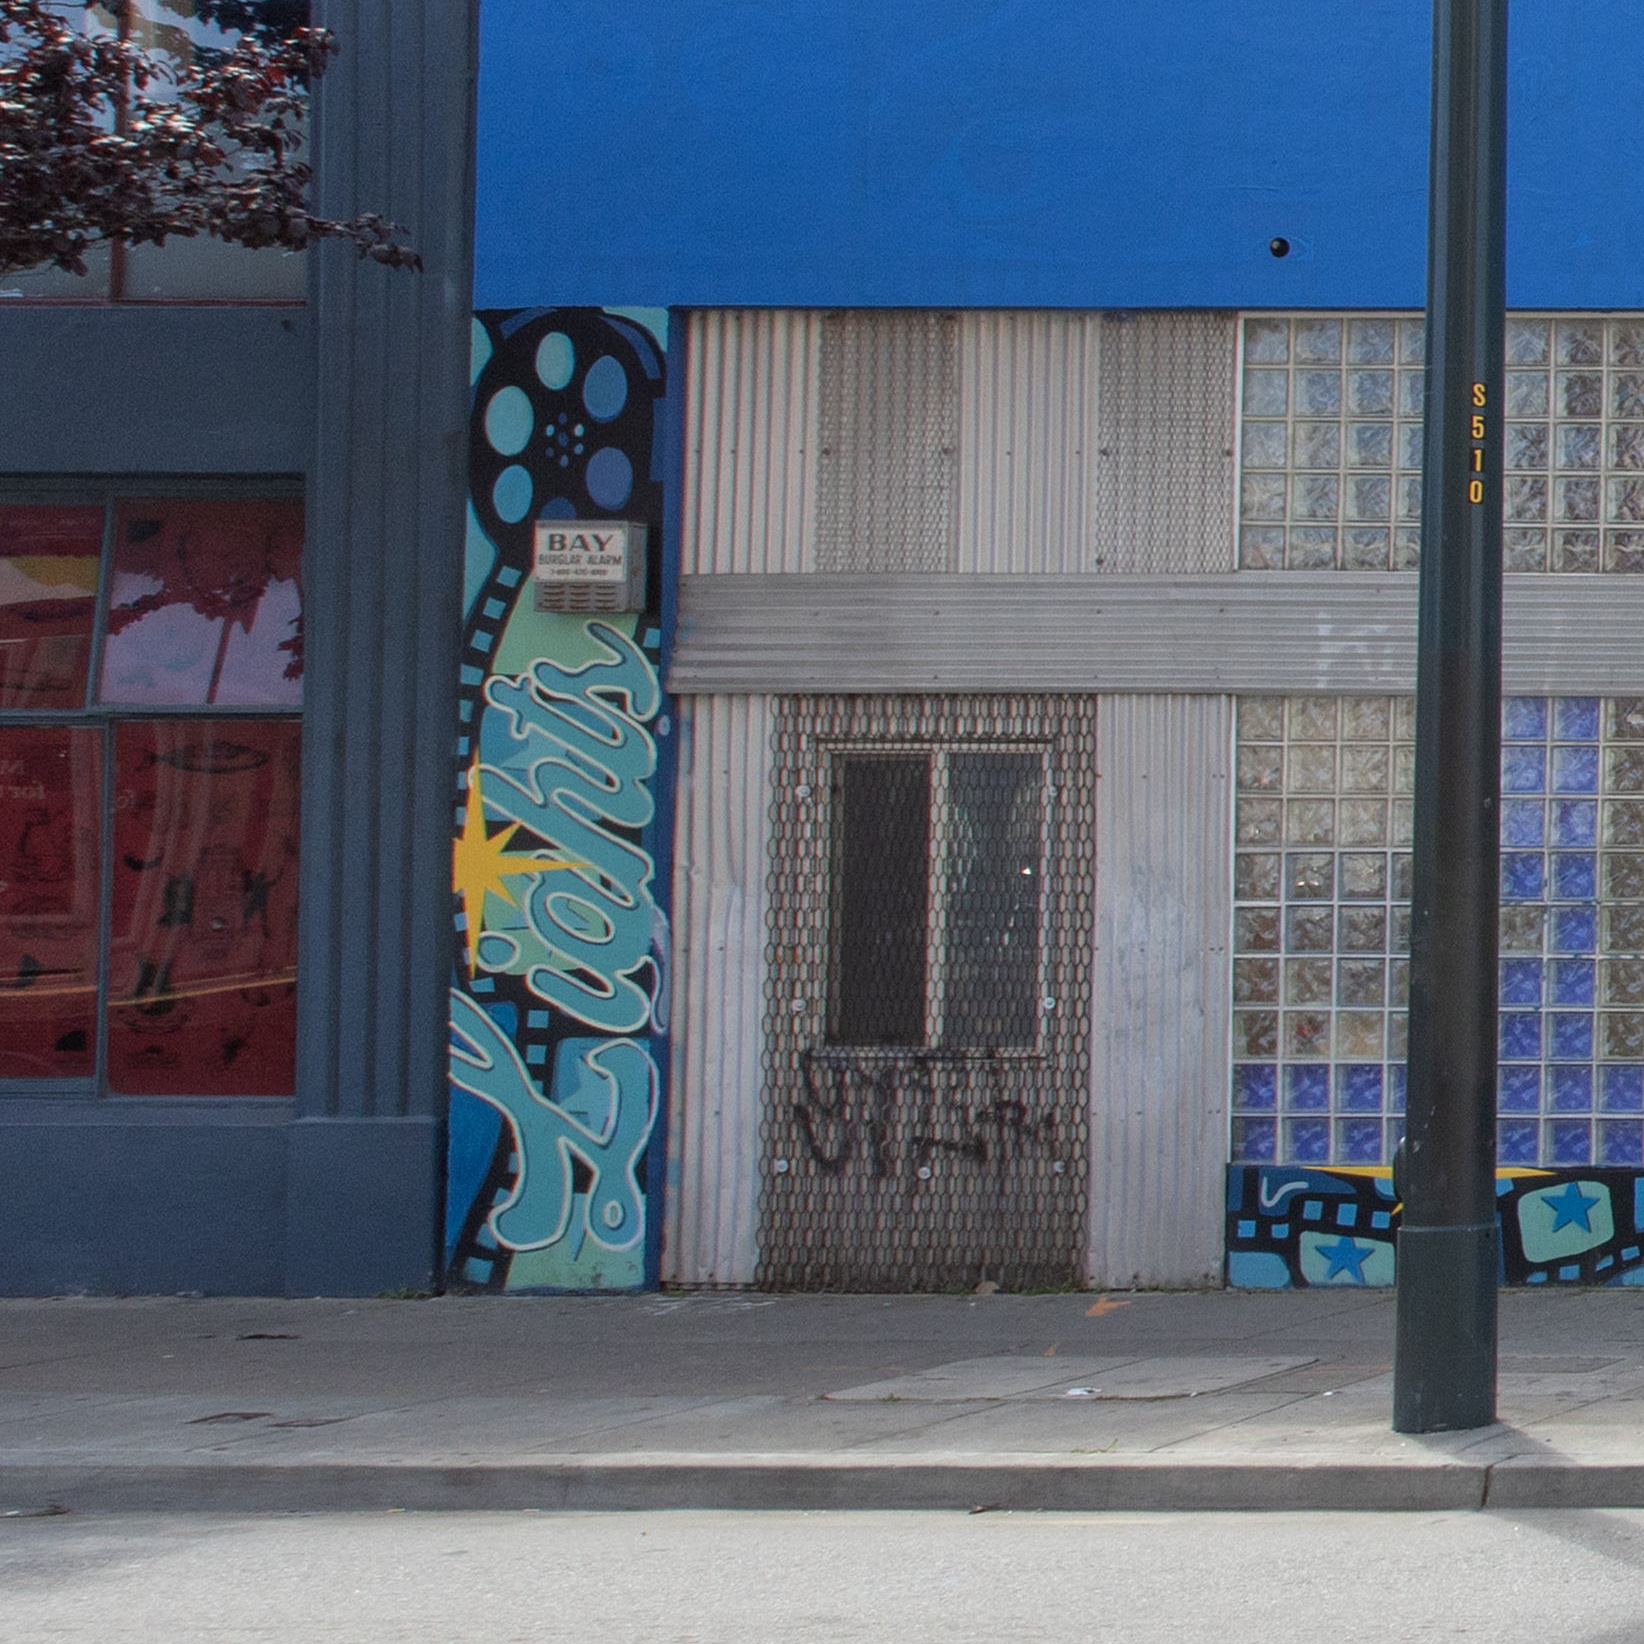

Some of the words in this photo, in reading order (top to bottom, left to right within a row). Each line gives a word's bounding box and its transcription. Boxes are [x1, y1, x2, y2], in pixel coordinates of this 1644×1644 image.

[1469, 383, 1486, 503] S510
[547, 533, 614, 551] BAY
[538, 554, 583, 565] BURGLAR
[587, 554, 622, 565] ALARM
